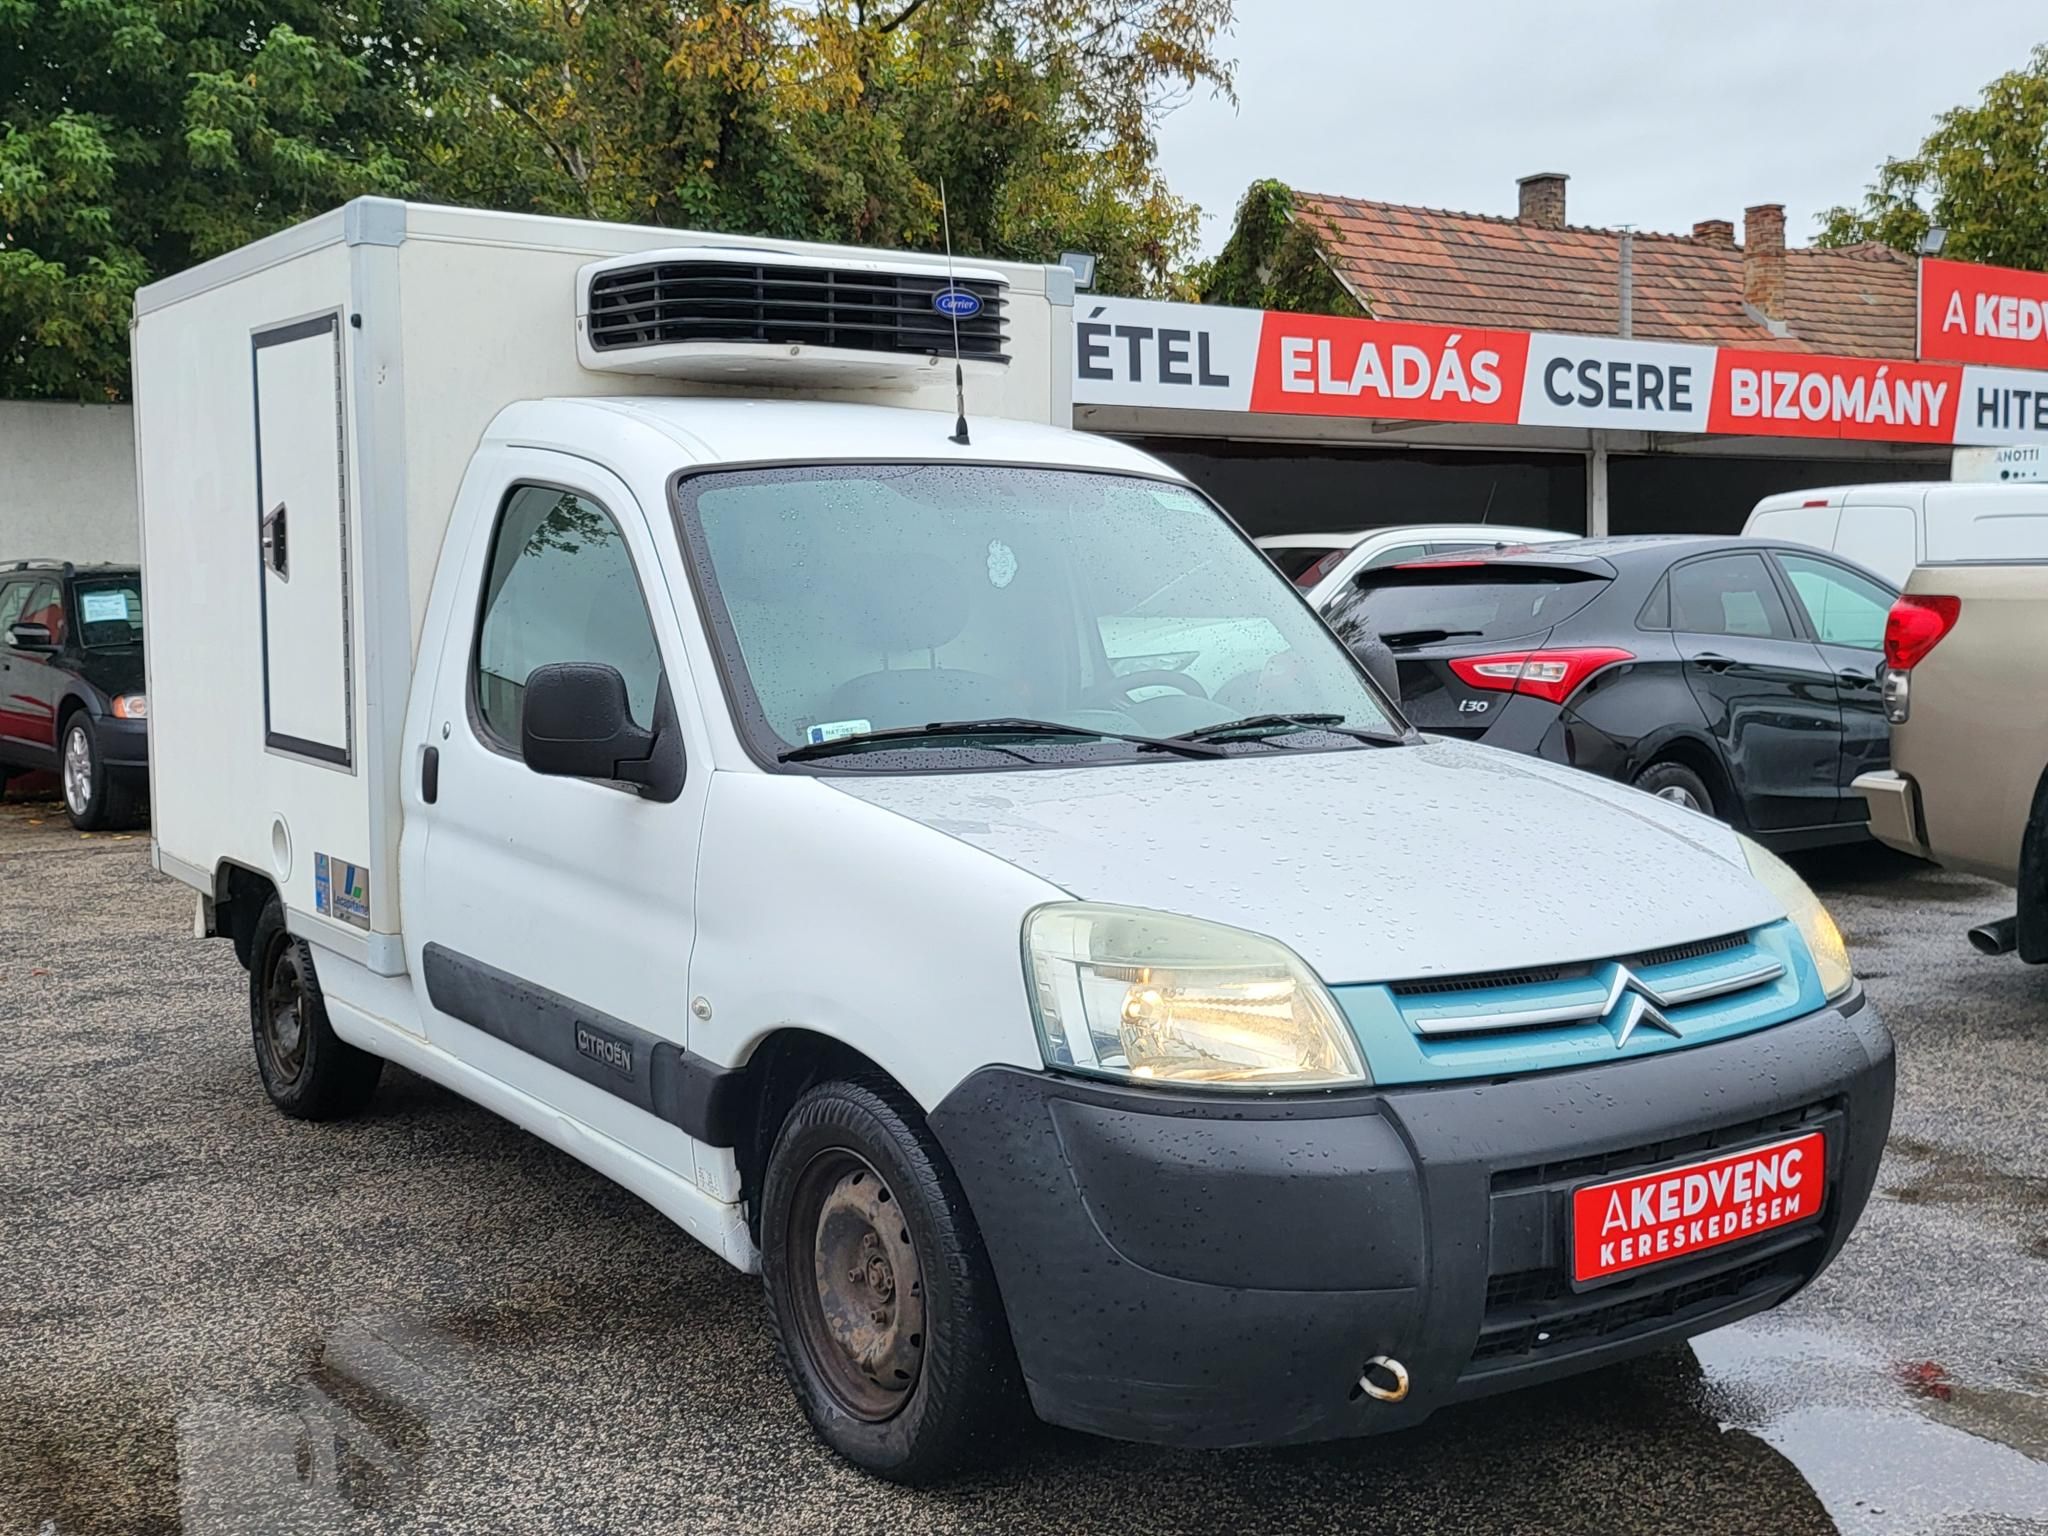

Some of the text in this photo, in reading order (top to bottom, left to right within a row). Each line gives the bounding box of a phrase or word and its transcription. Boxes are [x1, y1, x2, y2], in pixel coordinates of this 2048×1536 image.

[941, 298, 973, 309] Carrier
[1942, 289, 1968, 334] A
[1077, 307, 1230, 387] ÉTEL
[1280, 333, 1502, 405] ELADÁS
[1543, 357, 1693, 412] CSERE
[1730, 366, 1947, 427] BIZOMÁNY
[1977, 387, 2048, 430] HITE
[1458, 699, 1489, 712] i30
[577, 1030, 632, 1071] CITROËN
[1600, 1193, 1801, 1268] KERESKEDÉSEM
